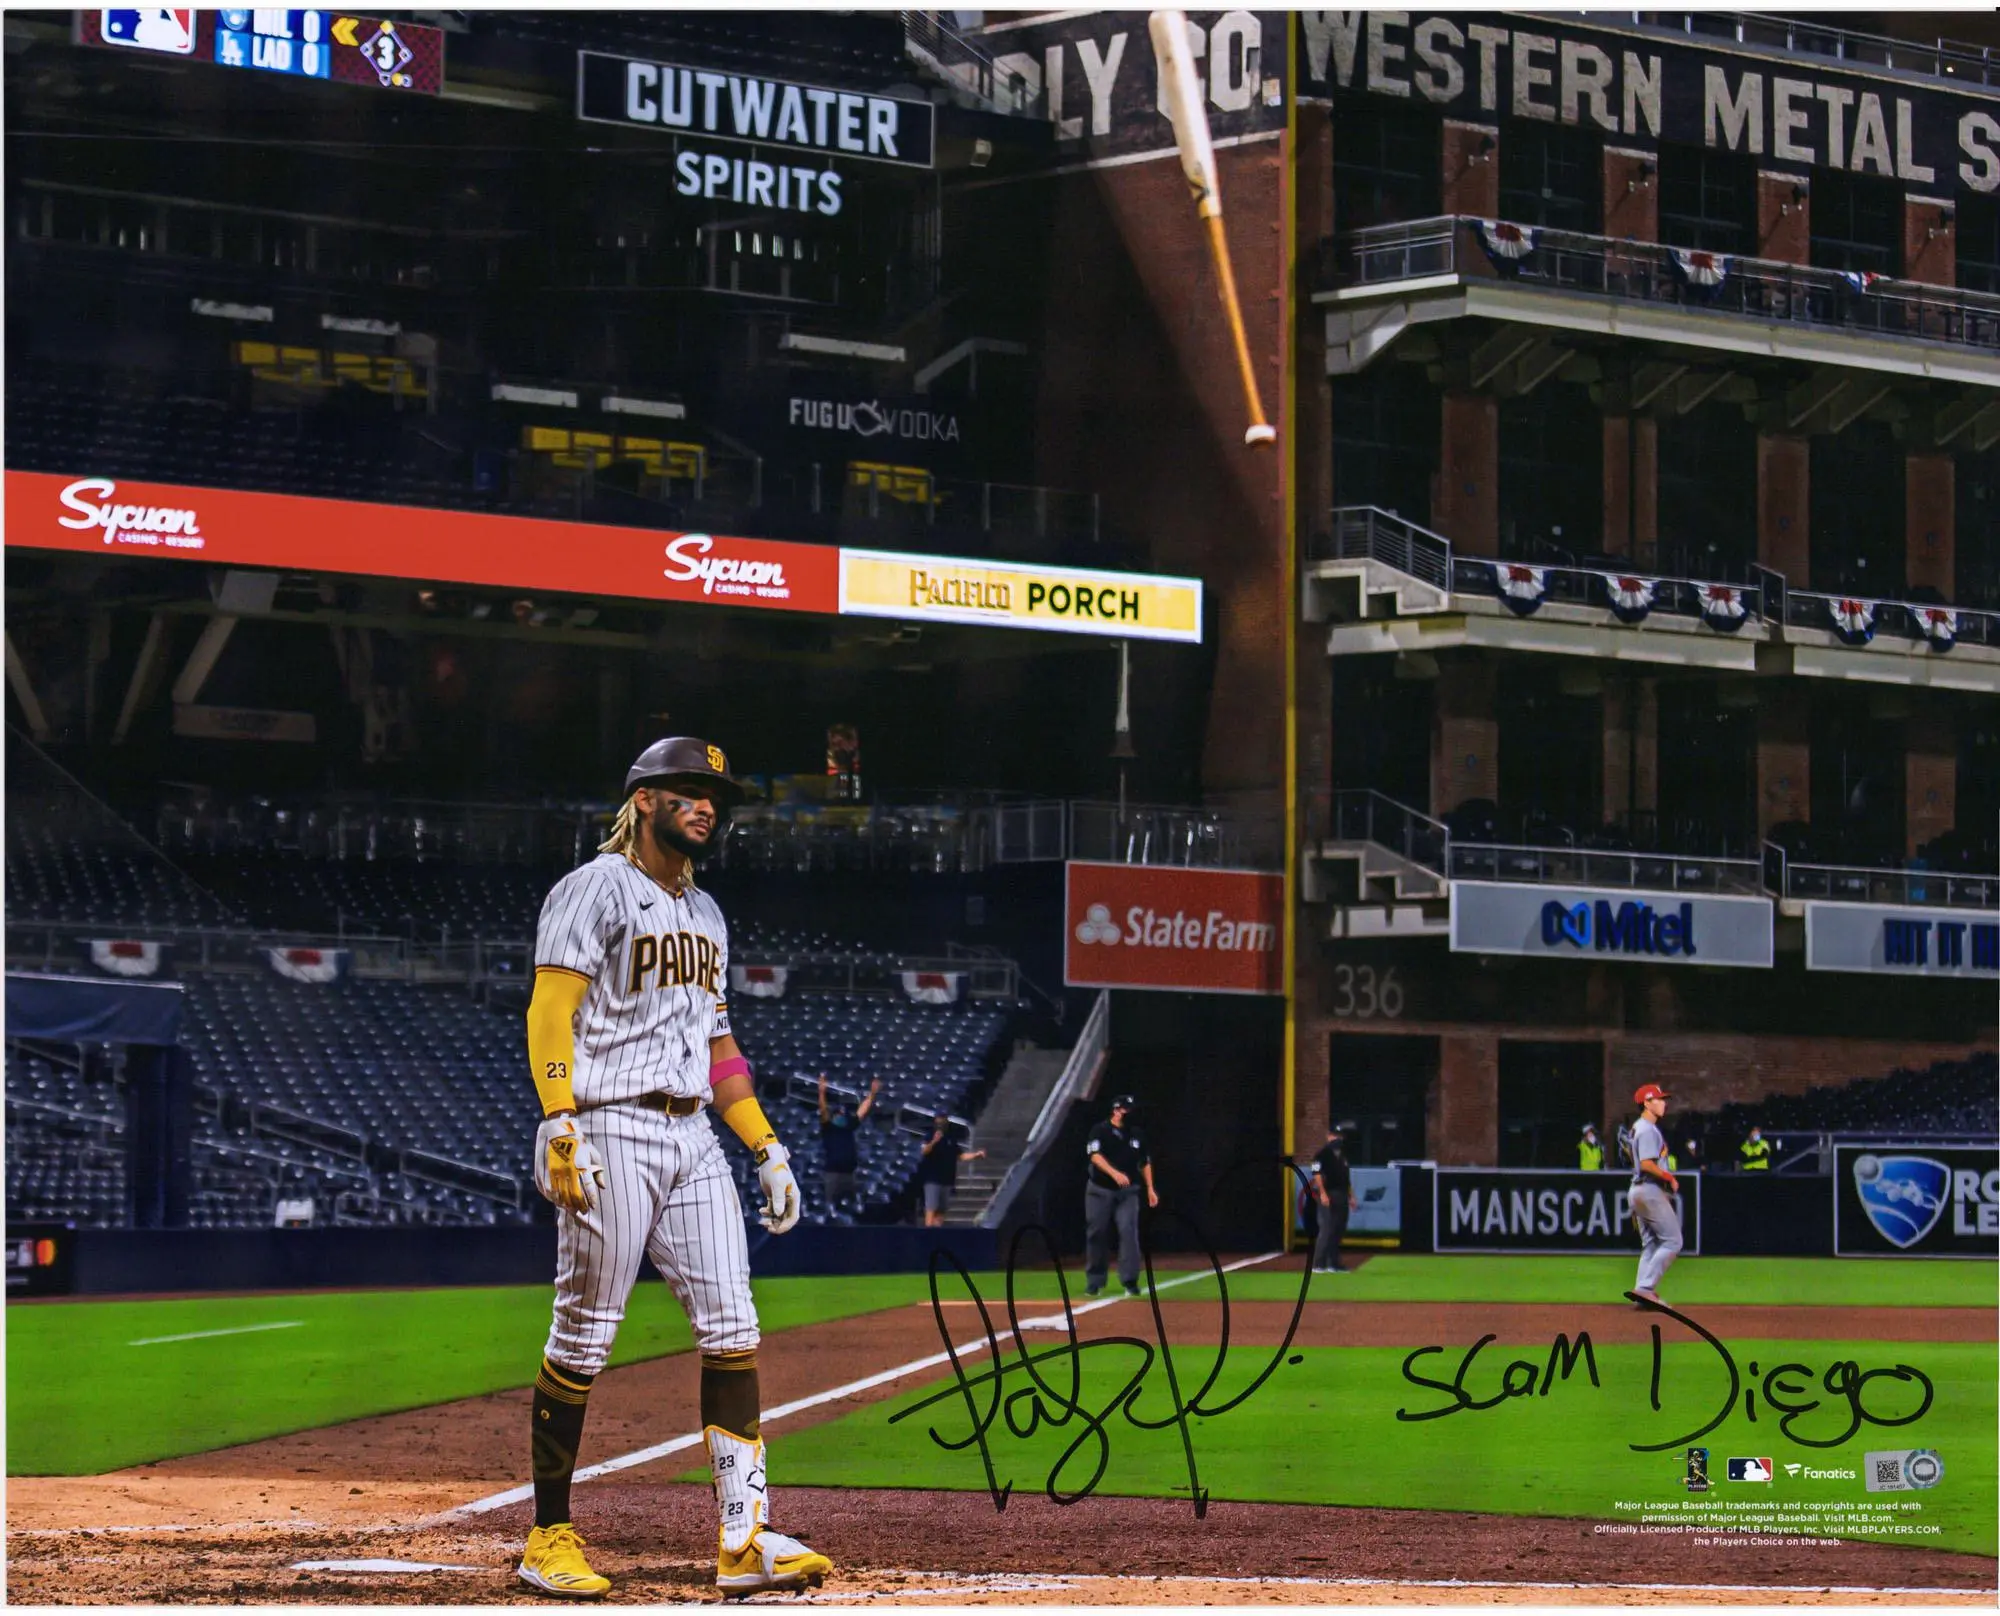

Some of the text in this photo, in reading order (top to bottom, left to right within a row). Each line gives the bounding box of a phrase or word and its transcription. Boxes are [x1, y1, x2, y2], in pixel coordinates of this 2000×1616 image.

[302, 43, 319, 76] 0
[377, 36, 395, 70] 3
[626, 61, 899, 157] CUTWATER
[1301, 10, 1662, 138] WESTERN
[1704, 65, 1935, 184] METAL
[676, 151, 844, 216] SPIRITS
[789, 398, 851, 430] FUGU
[58, 478, 200, 544] Sycuan
[663, 533, 786, 595] Sycuan
[1027, 582, 1140, 621] PORCH
[1595, 899, 1697, 957] Mitel
[1334, 964, 1404, 1018] 336
[546, 1062, 567, 1079] 23
[1450, 1189, 1684, 1237] MANSCAP
[719, 1454, 735, 1470] 23
[728, 1501, 744, 1516] 23
